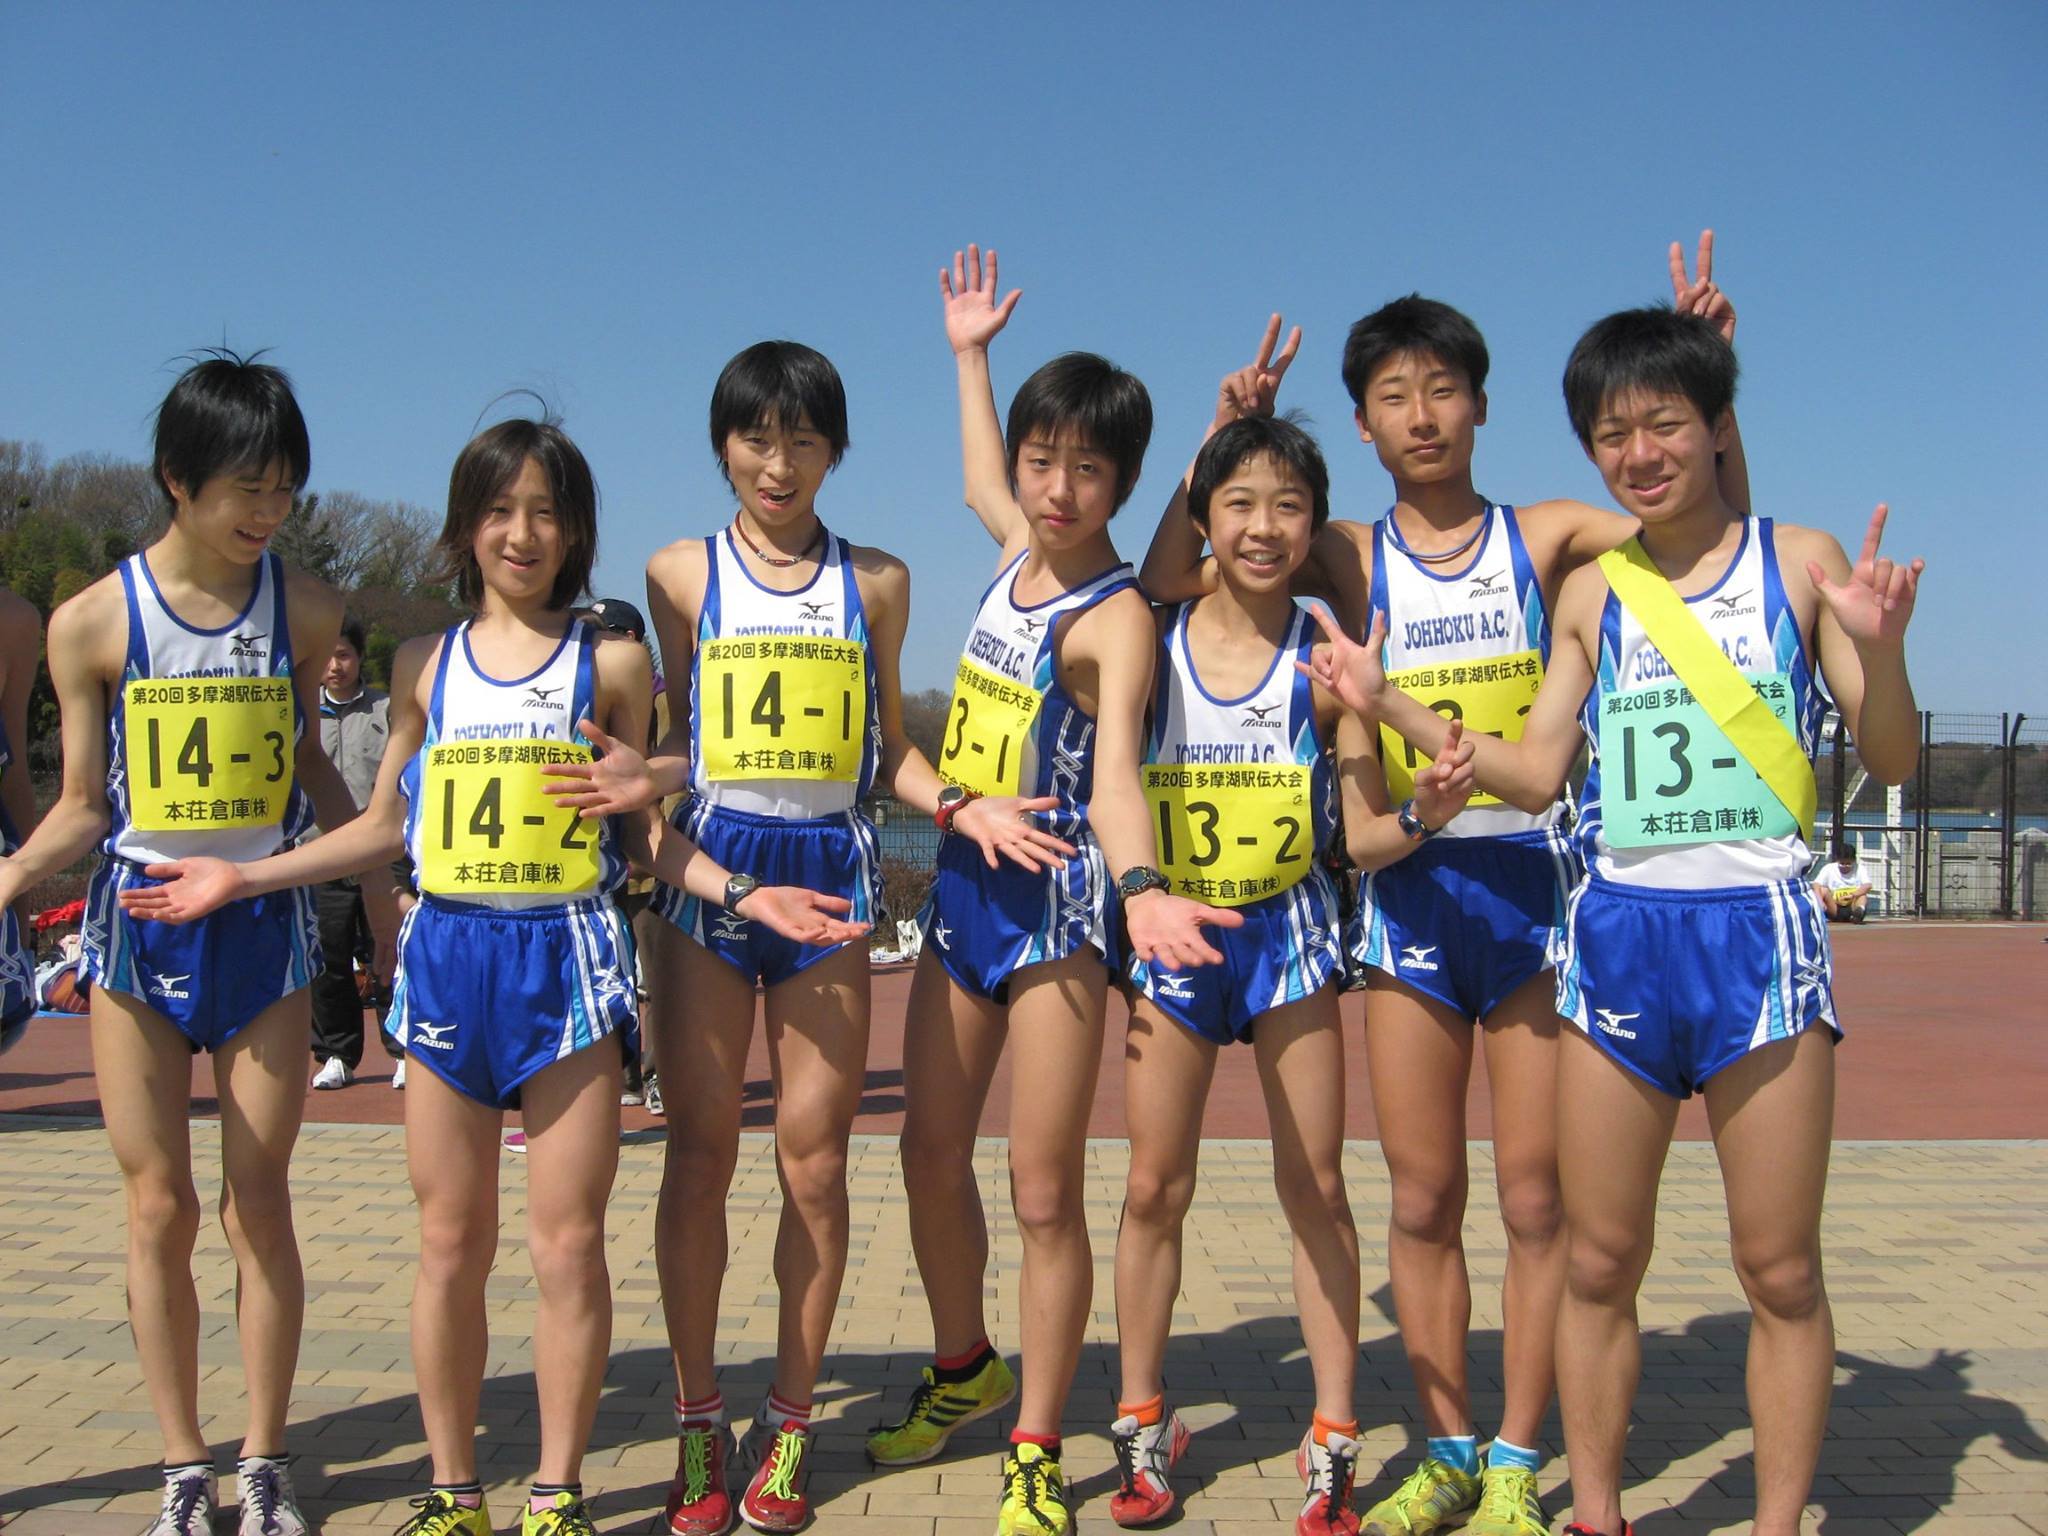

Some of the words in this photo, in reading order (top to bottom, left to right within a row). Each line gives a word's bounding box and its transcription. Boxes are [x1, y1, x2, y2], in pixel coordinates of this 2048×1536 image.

[1404, 613, 1475, 651] JOHHOKU
[1480, 609, 1510, 638] A.C.
[723, 671, 851, 741] 14-1
[945, 692, 1009, 784] 3-1
[148, 716, 285, 788] 14-3
[1623, 721, 1763, 801] 13-
[1159, 801, 1302, 867] 13-2
